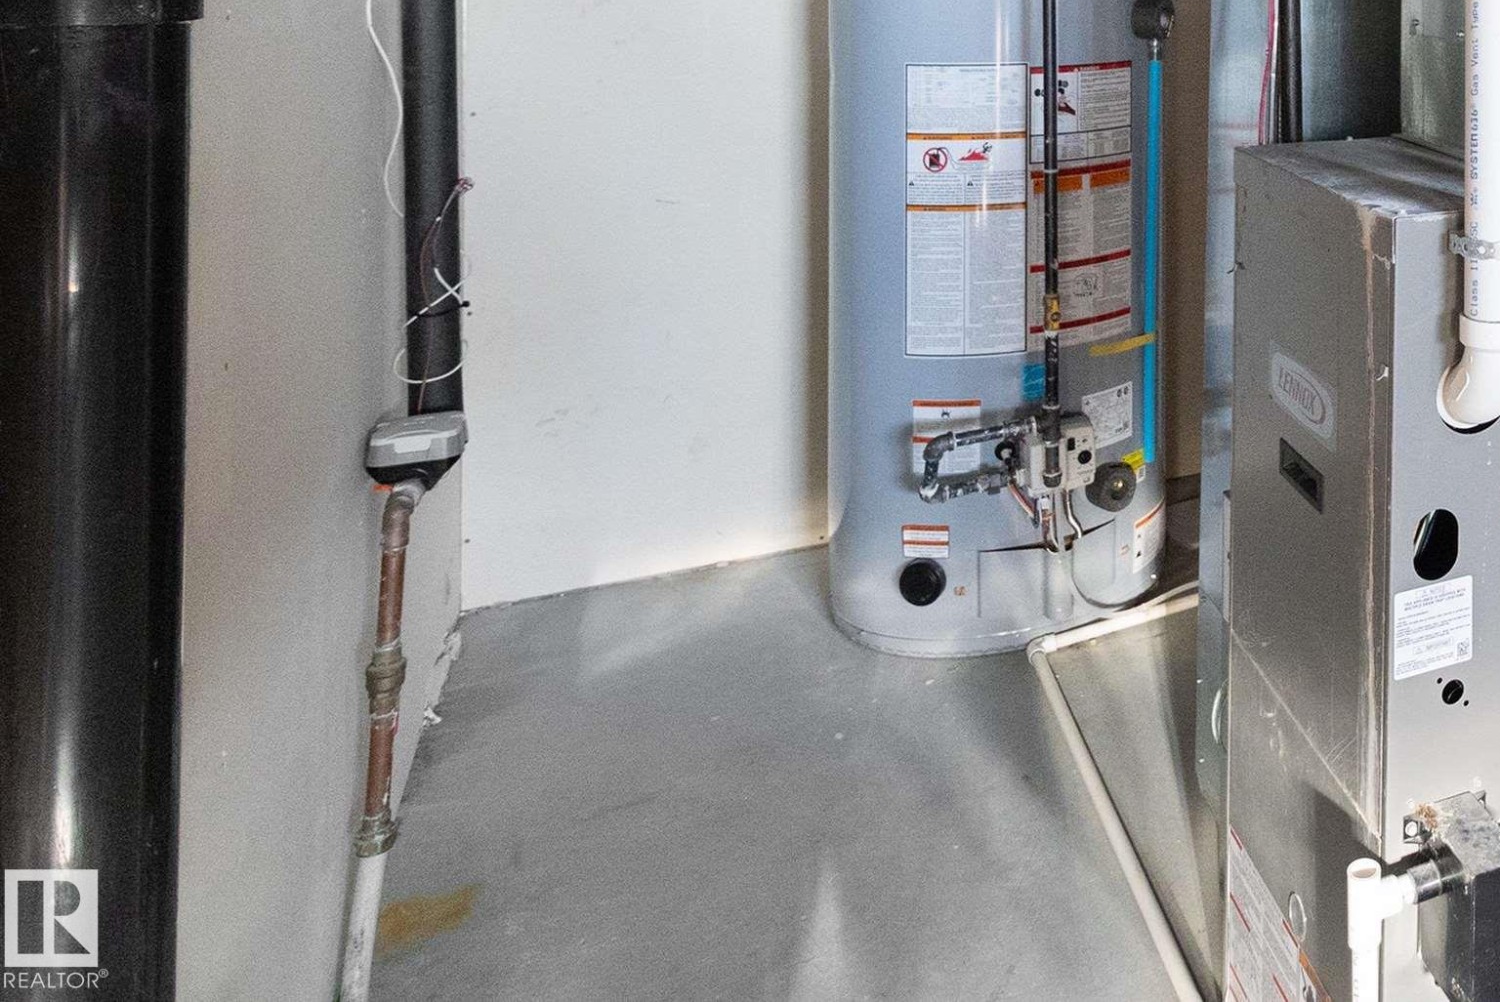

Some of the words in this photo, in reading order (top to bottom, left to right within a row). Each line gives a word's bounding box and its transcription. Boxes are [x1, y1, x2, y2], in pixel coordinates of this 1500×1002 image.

[1469, 0, 1480, 29] Type
[1469, 38, 1480, 67] Vent
[1469, 73, 1479, 96] Gas
[1469, 279, 1479, 317] Class
[1279, 366, 1316, 416] LENNOX
